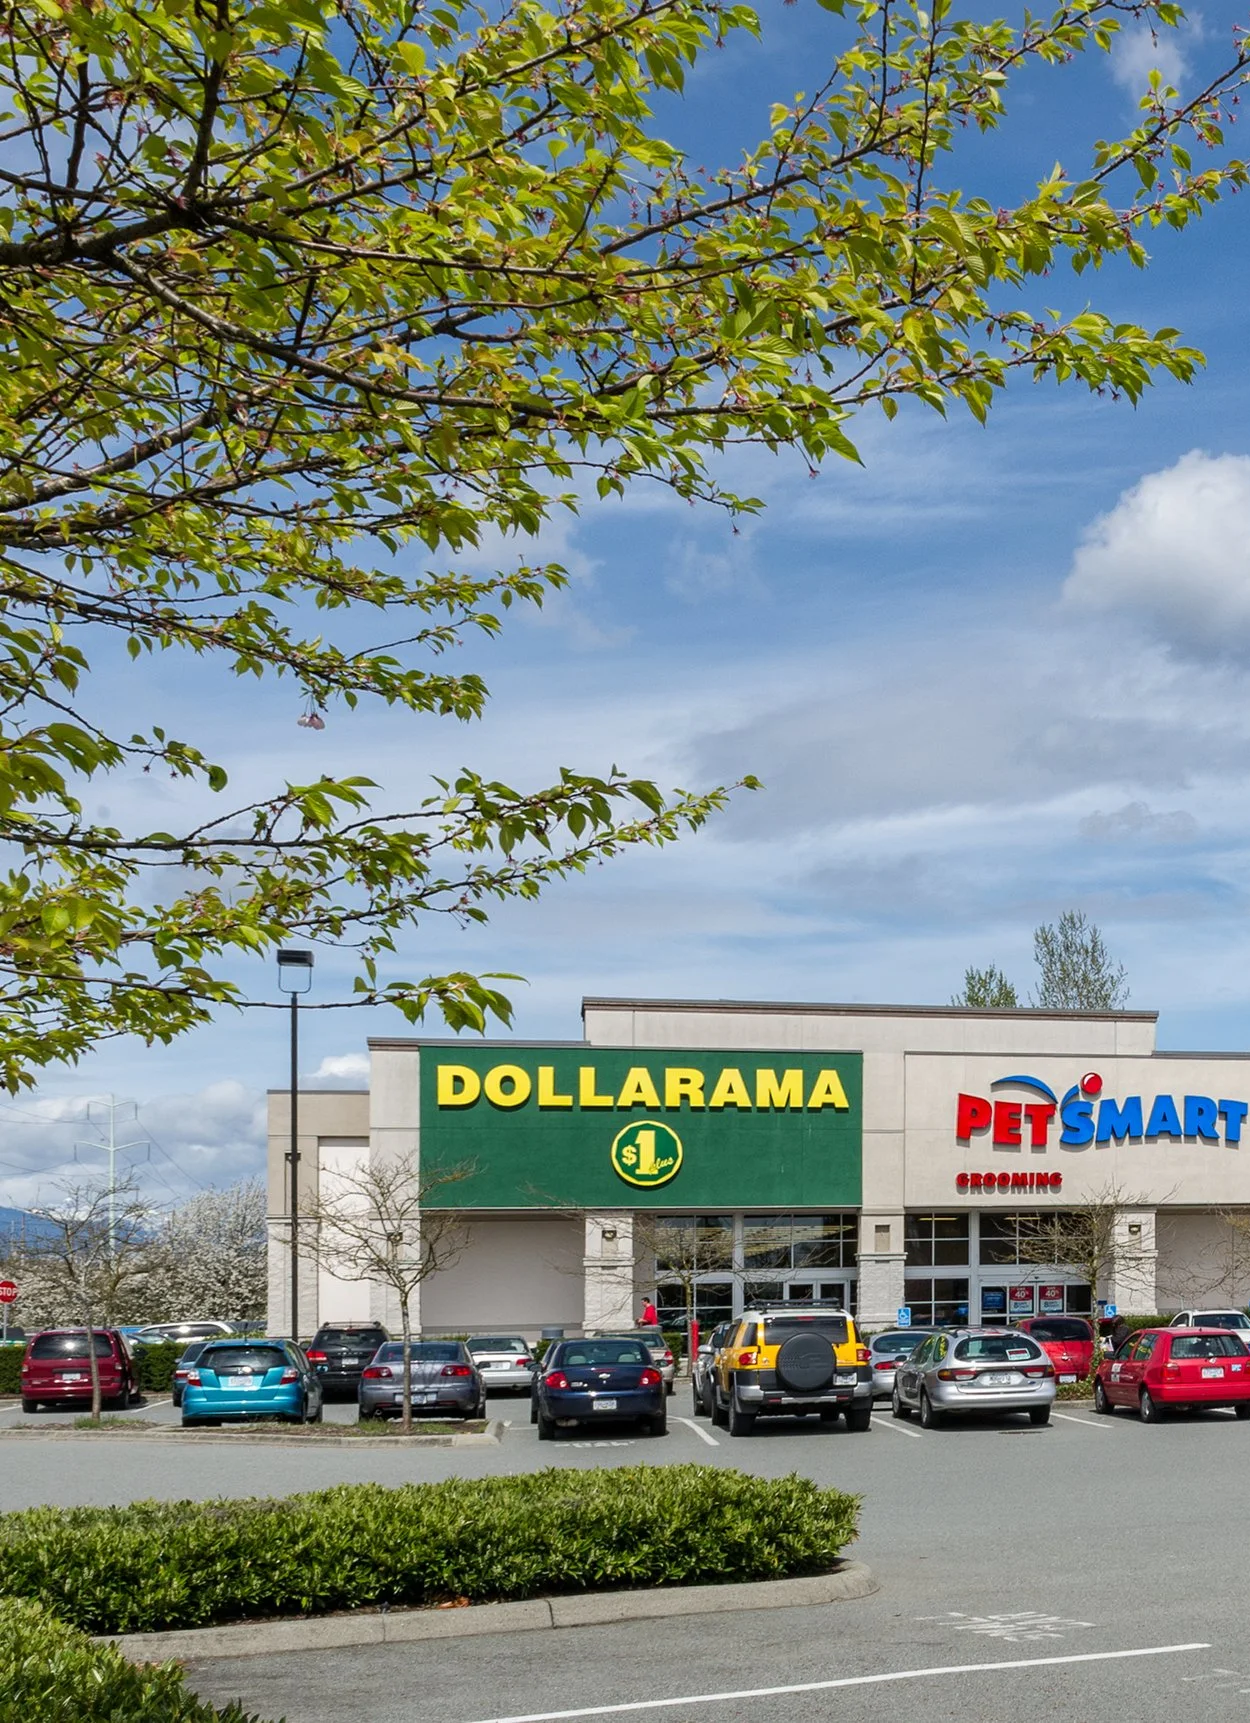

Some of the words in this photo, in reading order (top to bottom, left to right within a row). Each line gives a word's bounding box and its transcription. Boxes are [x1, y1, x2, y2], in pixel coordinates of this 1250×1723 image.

[437, 1064, 850, 1109] DOLLARAMA
[621, 1129, 659, 1175] $1
[649, 1157, 674, 1175] plus
[956, 1172, 1062, 1188] GROOMING
[0, 1287, 17, 1297] STOP
